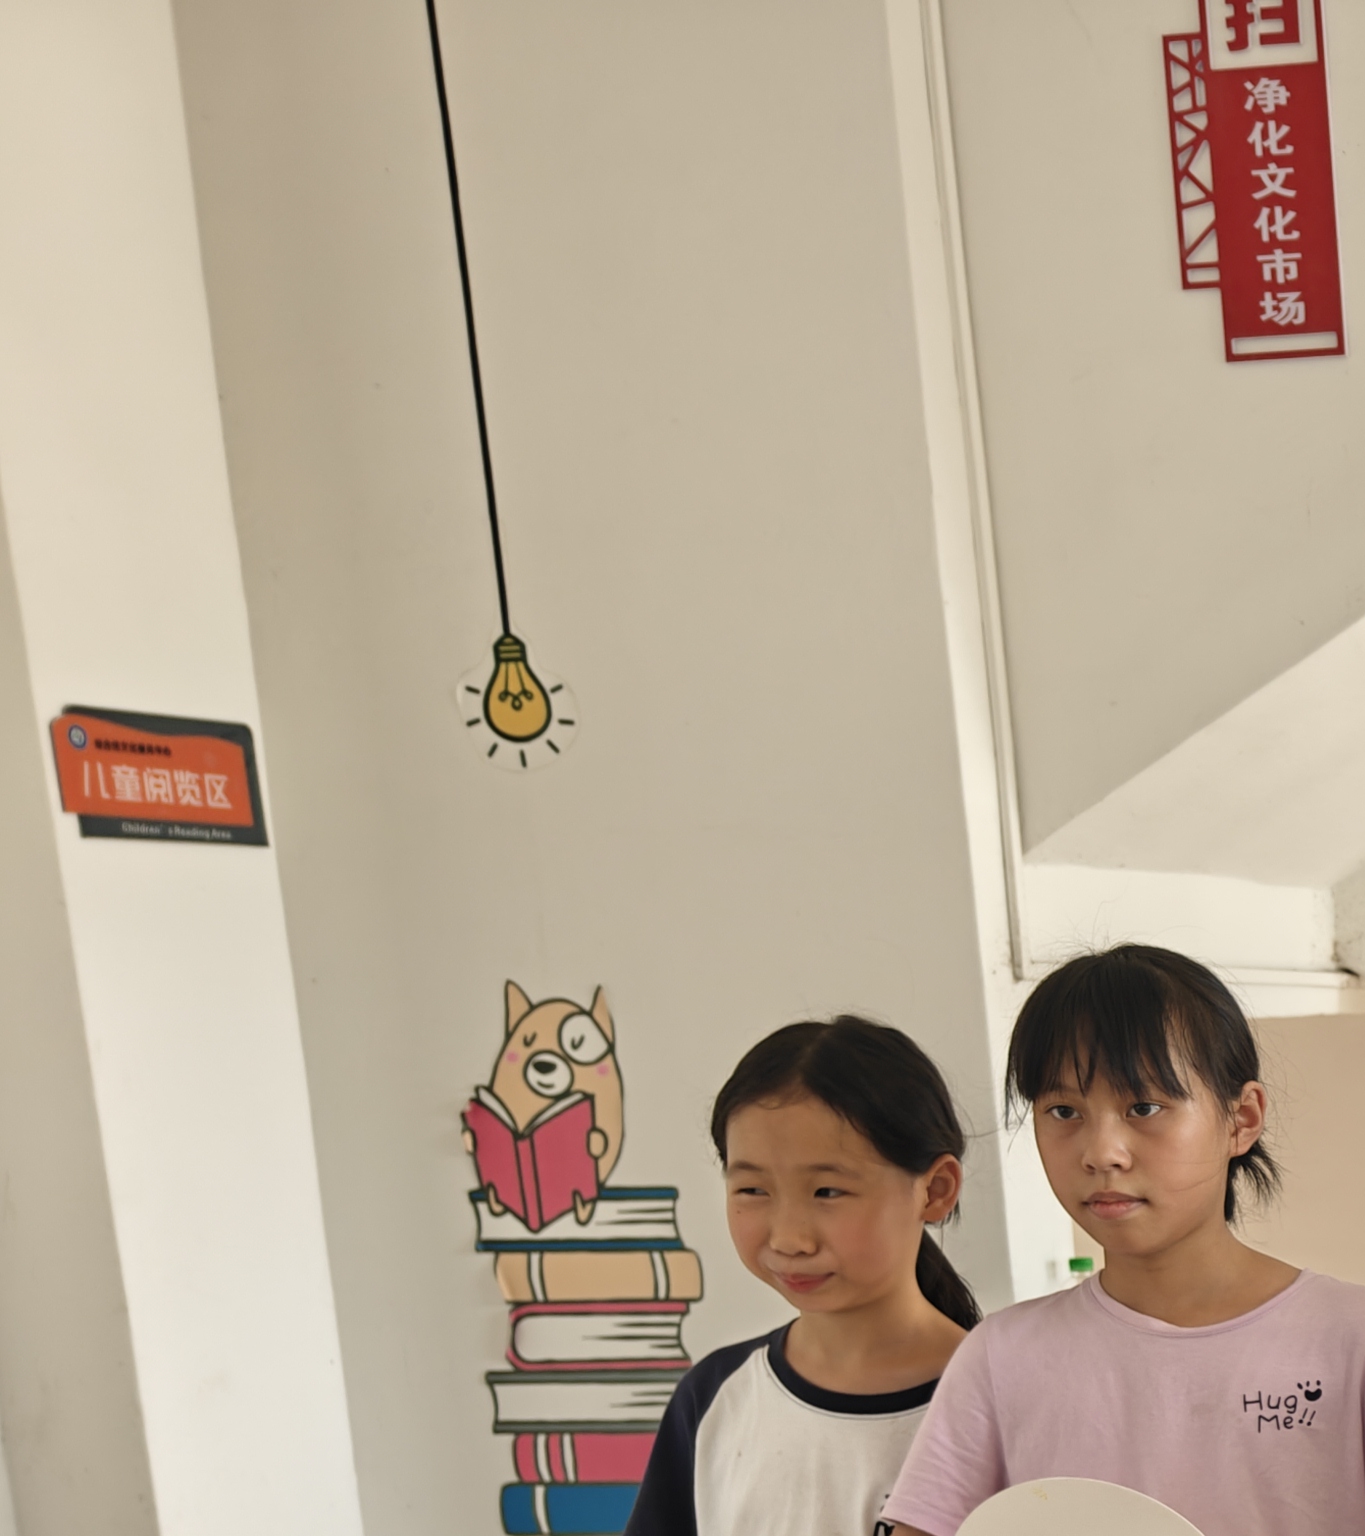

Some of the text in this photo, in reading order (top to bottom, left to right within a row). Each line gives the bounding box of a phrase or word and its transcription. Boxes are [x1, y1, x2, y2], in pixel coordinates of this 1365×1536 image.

[1244, 77, 1306, 327] 净化文化市场
[83, 761, 233, 809] 儿童阅览区
[1242, 1390, 1298, 1414] Hug
